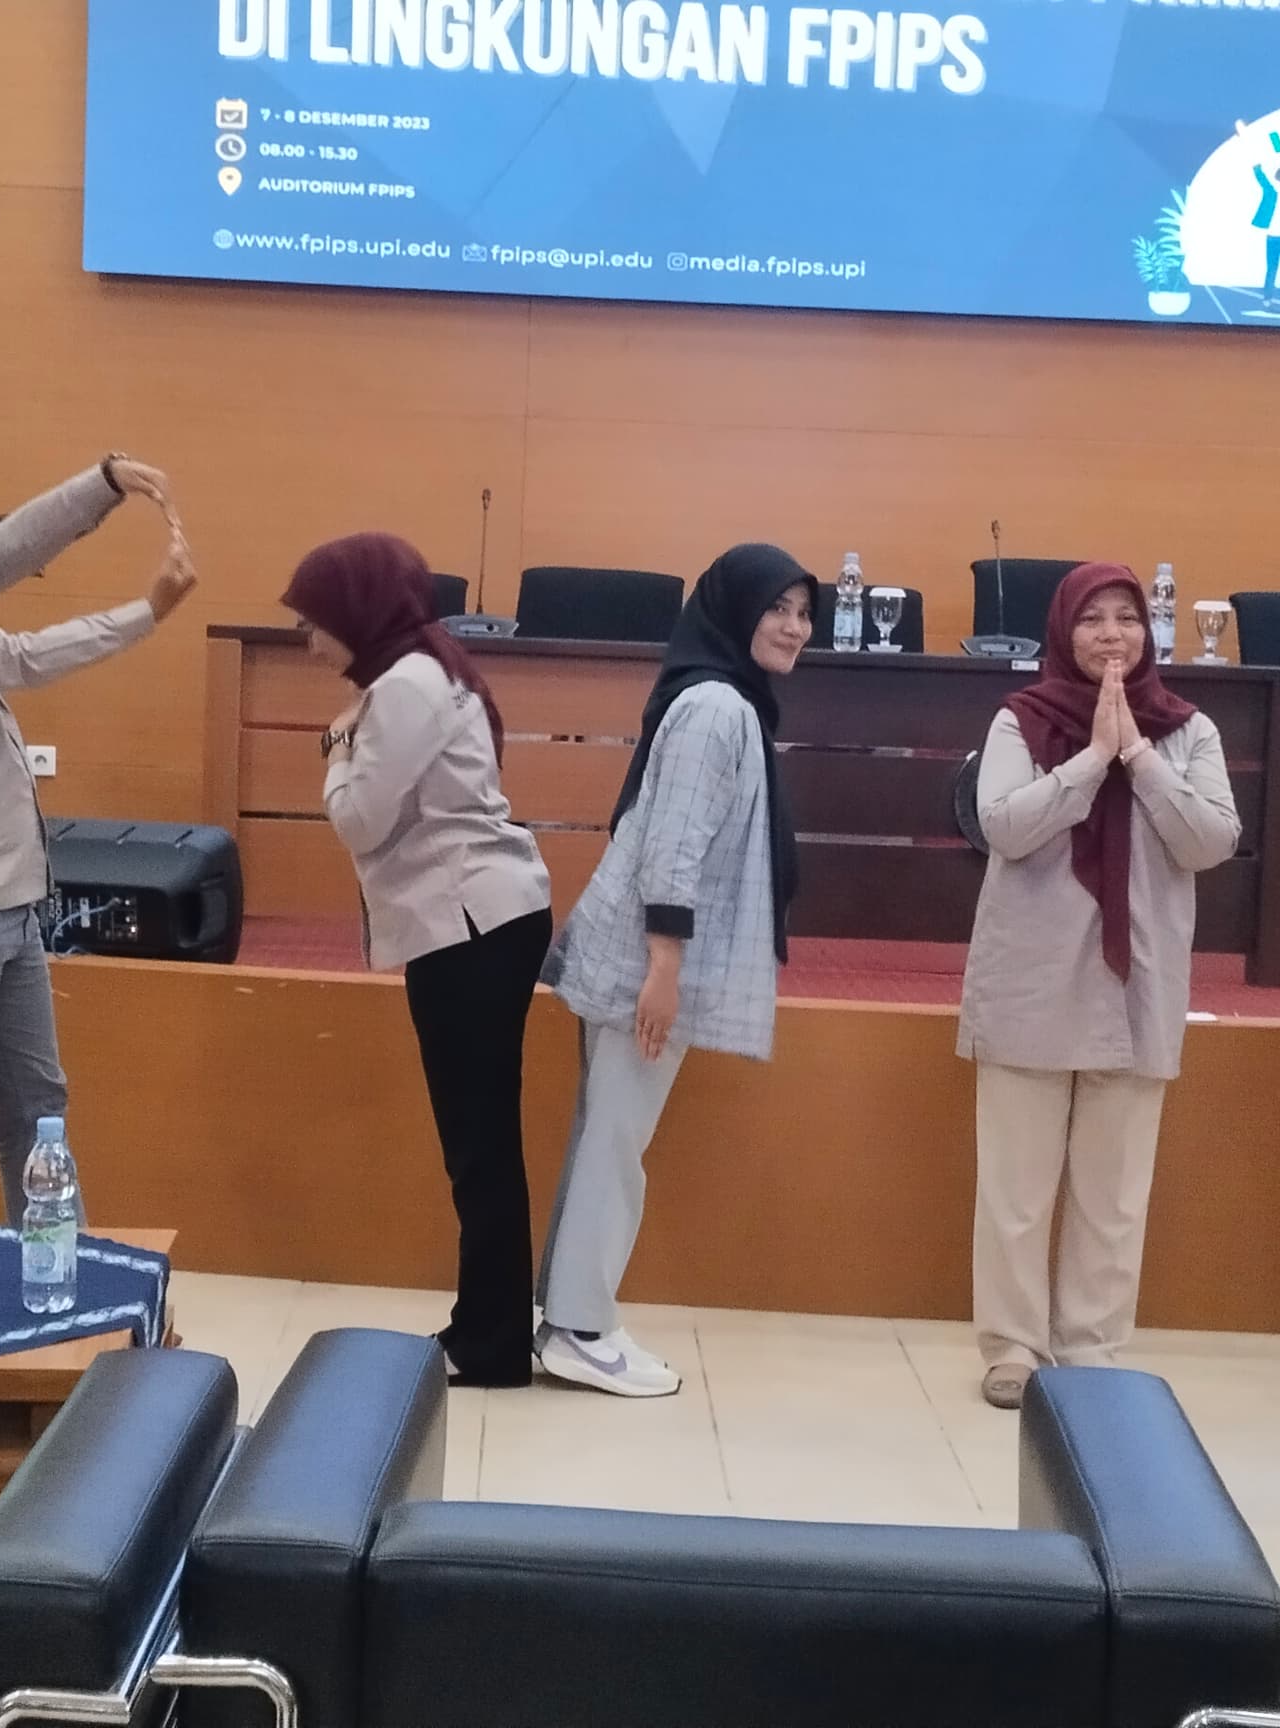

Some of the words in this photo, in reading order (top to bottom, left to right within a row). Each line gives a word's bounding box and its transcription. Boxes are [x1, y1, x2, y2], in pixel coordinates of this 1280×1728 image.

[218, 0, 287, 60] DI
[310, 0, 768, 86] LINGKUNGAN
[788, 6, 987, 96] FPIPS
[260, 108, 271, 122] 7
[284, 109, 296, 123] 8
[299, 110, 389, 128] DESEMBER
[392, 116, 431, 130] 2023
[259, 142, 305, 158] 08.00
[319, 146, 358, 161] 15.30
[258, 177, 365, 197] AUDITORIUM
[368, 182, 416, 199] FPIPS
[235, 233, 451, 260] www.fpips.upi.edu
[491, 244, 653, 269] fpips@upi.edu
[689, 255, 867, 280] media.fpips.upi
